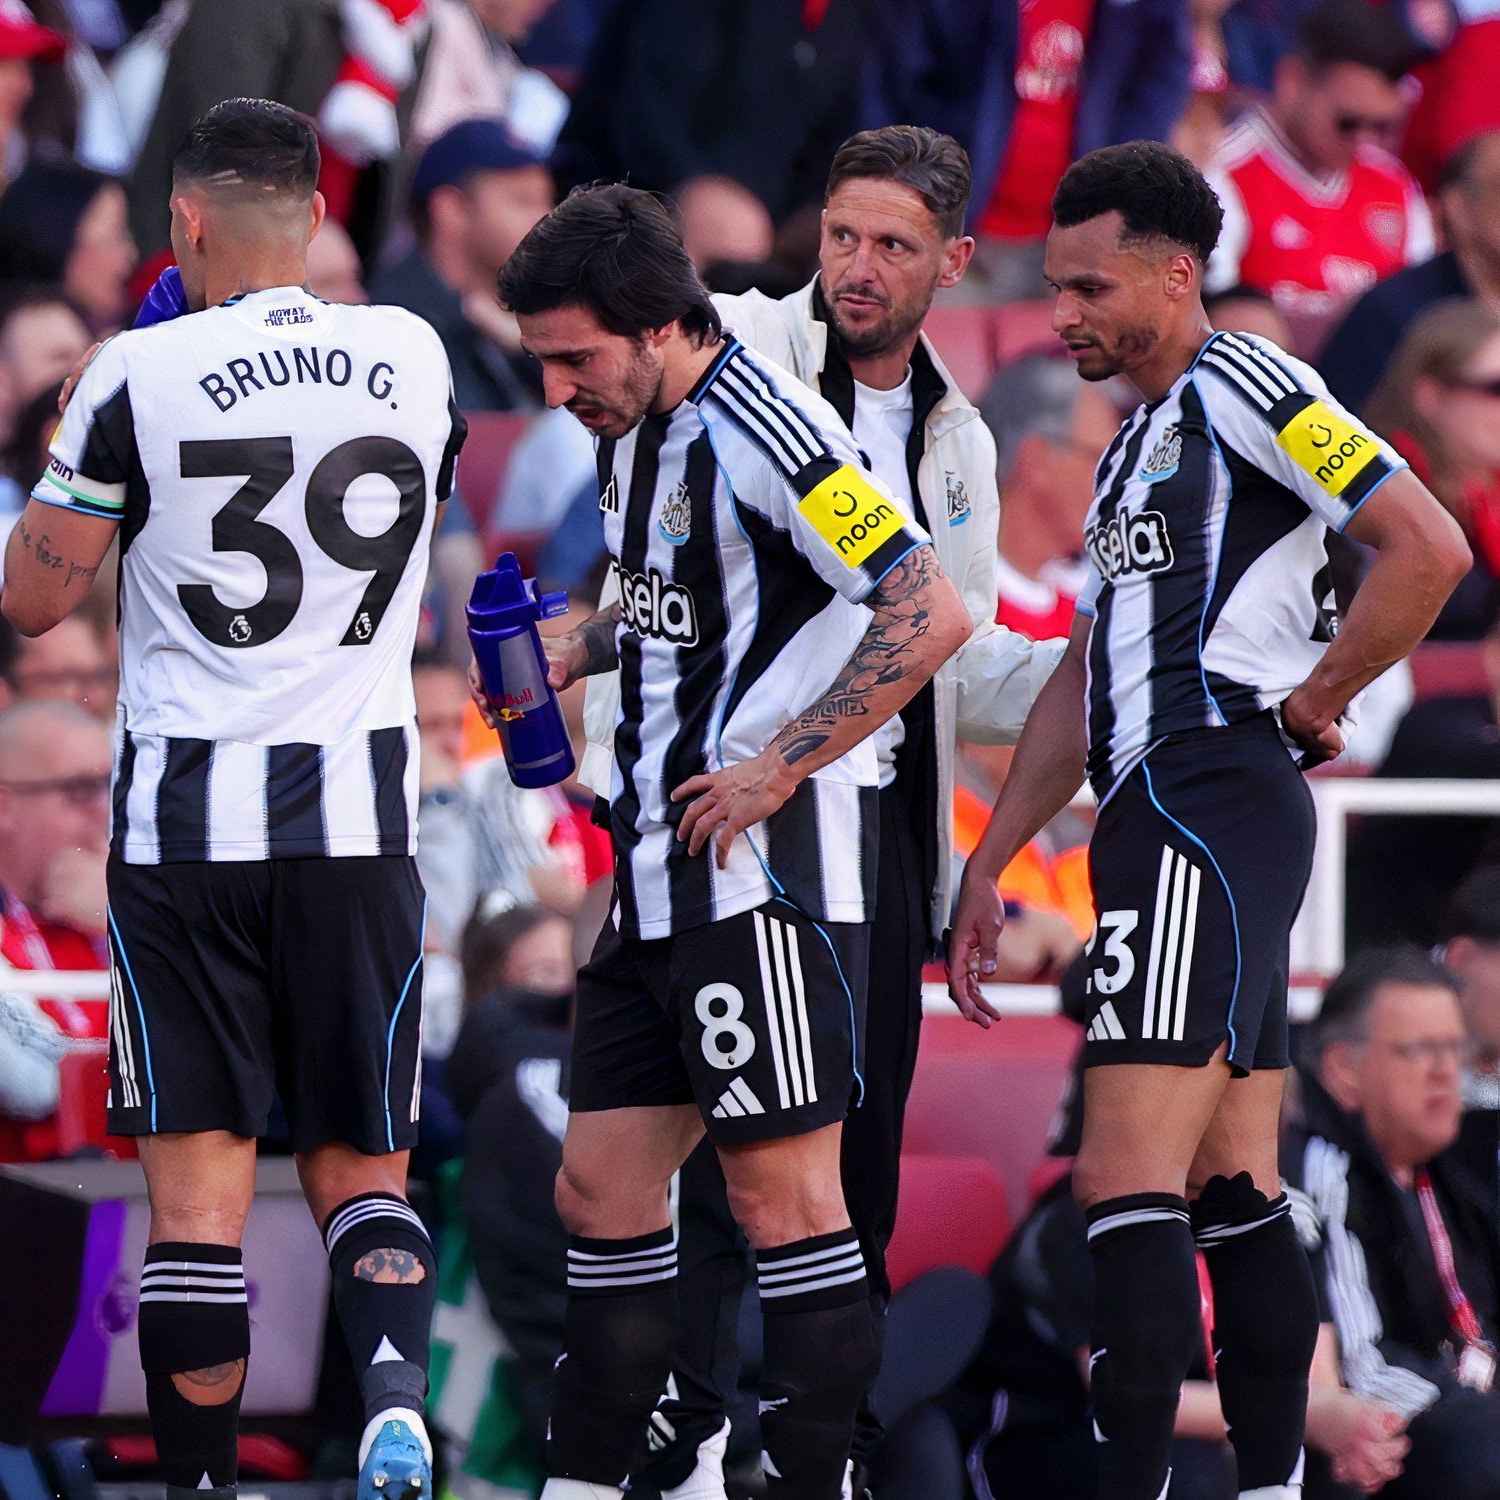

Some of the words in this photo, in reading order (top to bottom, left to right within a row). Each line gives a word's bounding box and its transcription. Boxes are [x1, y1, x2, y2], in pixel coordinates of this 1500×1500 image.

[198, 346, 352, 413] BRUNO
[367, 362, 398, 410] G.
[1314, 433, 1369, 484] noon
[176, 435, 427, 648] 39
[835, 503, 894, 555] noon
[694, 982, 756, 1070] 8
